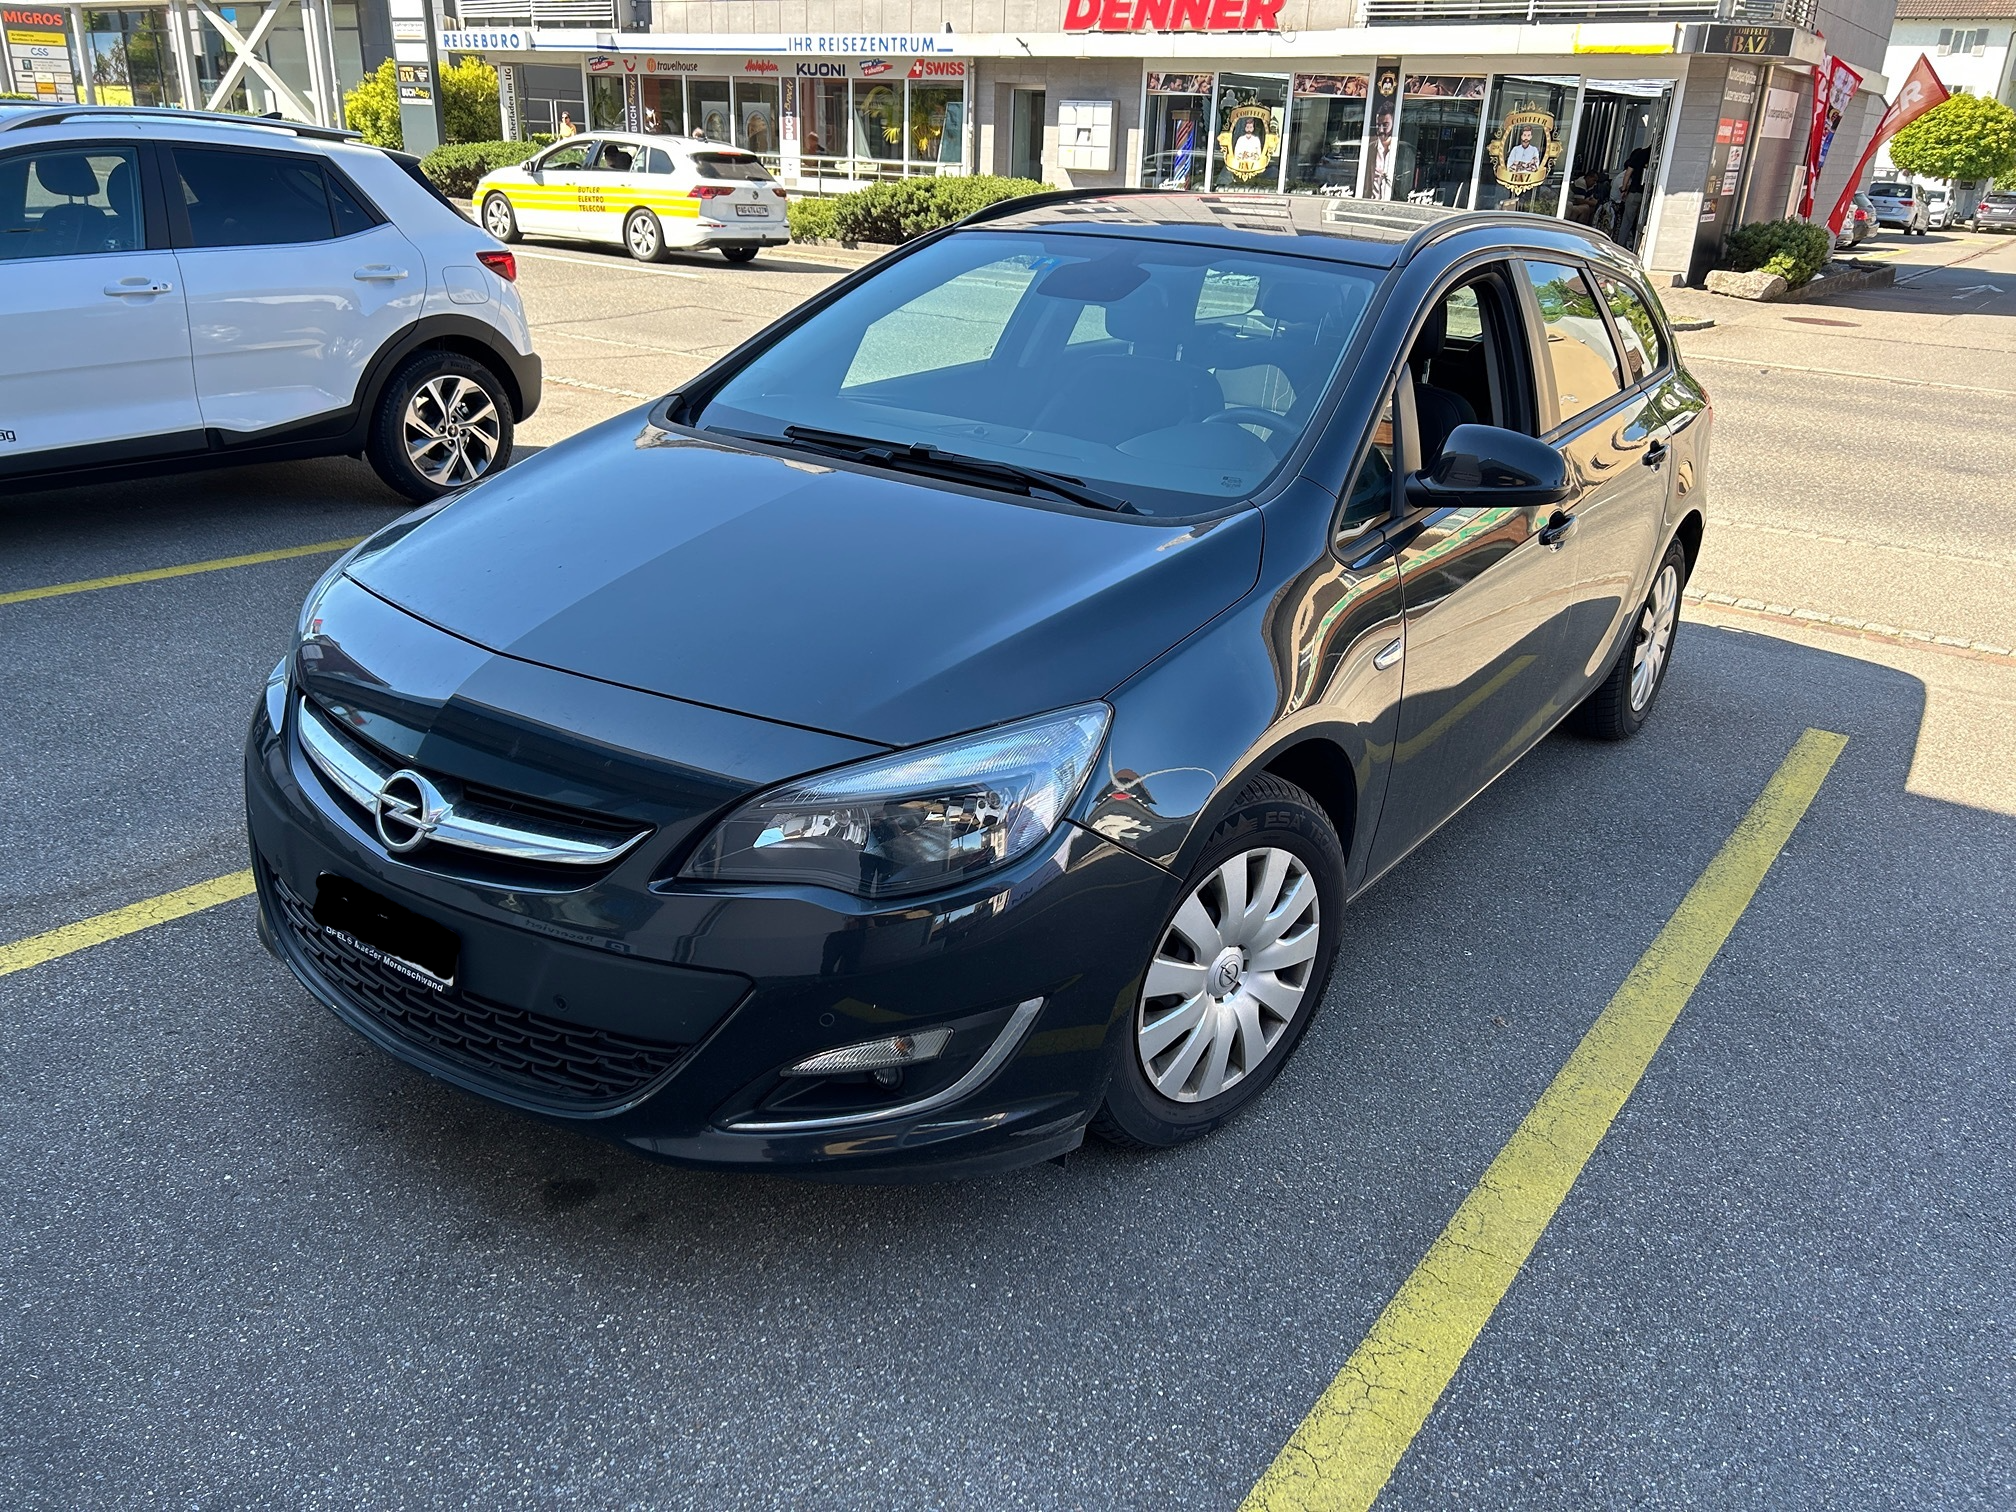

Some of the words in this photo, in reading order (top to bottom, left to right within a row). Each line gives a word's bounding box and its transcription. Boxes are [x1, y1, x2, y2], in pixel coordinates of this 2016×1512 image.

[3, 10, 63, 26] MIGROS
[1063, 0, 1285, 30] DENNER
[1733, 27, 1770, 36] COIFFEUR
[443, 33, 520, 49] REISEBÜRO
[788, 37, 813, 52] IHR
[819, 37, 935, 53] REISEZENTRUM
[1731, 35, 1768, 54] BAZ
[30, 47, 49, 57] CSS
[656, 60, 698, 72] travelhouse
[796, 62, 846, 77] KUONI
[925, 61, 965, 76] SWISS
[504, 68, 512, 80] UG
[507, 83, 513, 93] im
[508, 96, 517, 140] ücherladen
[630, 105, 638, 132] BUCH
[785, 111, 794, 140] BUCH
[1511, 116, 1548, 126] COIFFEUR
[1510, 173, 1532, 183] BAZ
[577, 195, 605, 203] ELEKTRO
[578, 204, 606, 212] TELECOM
